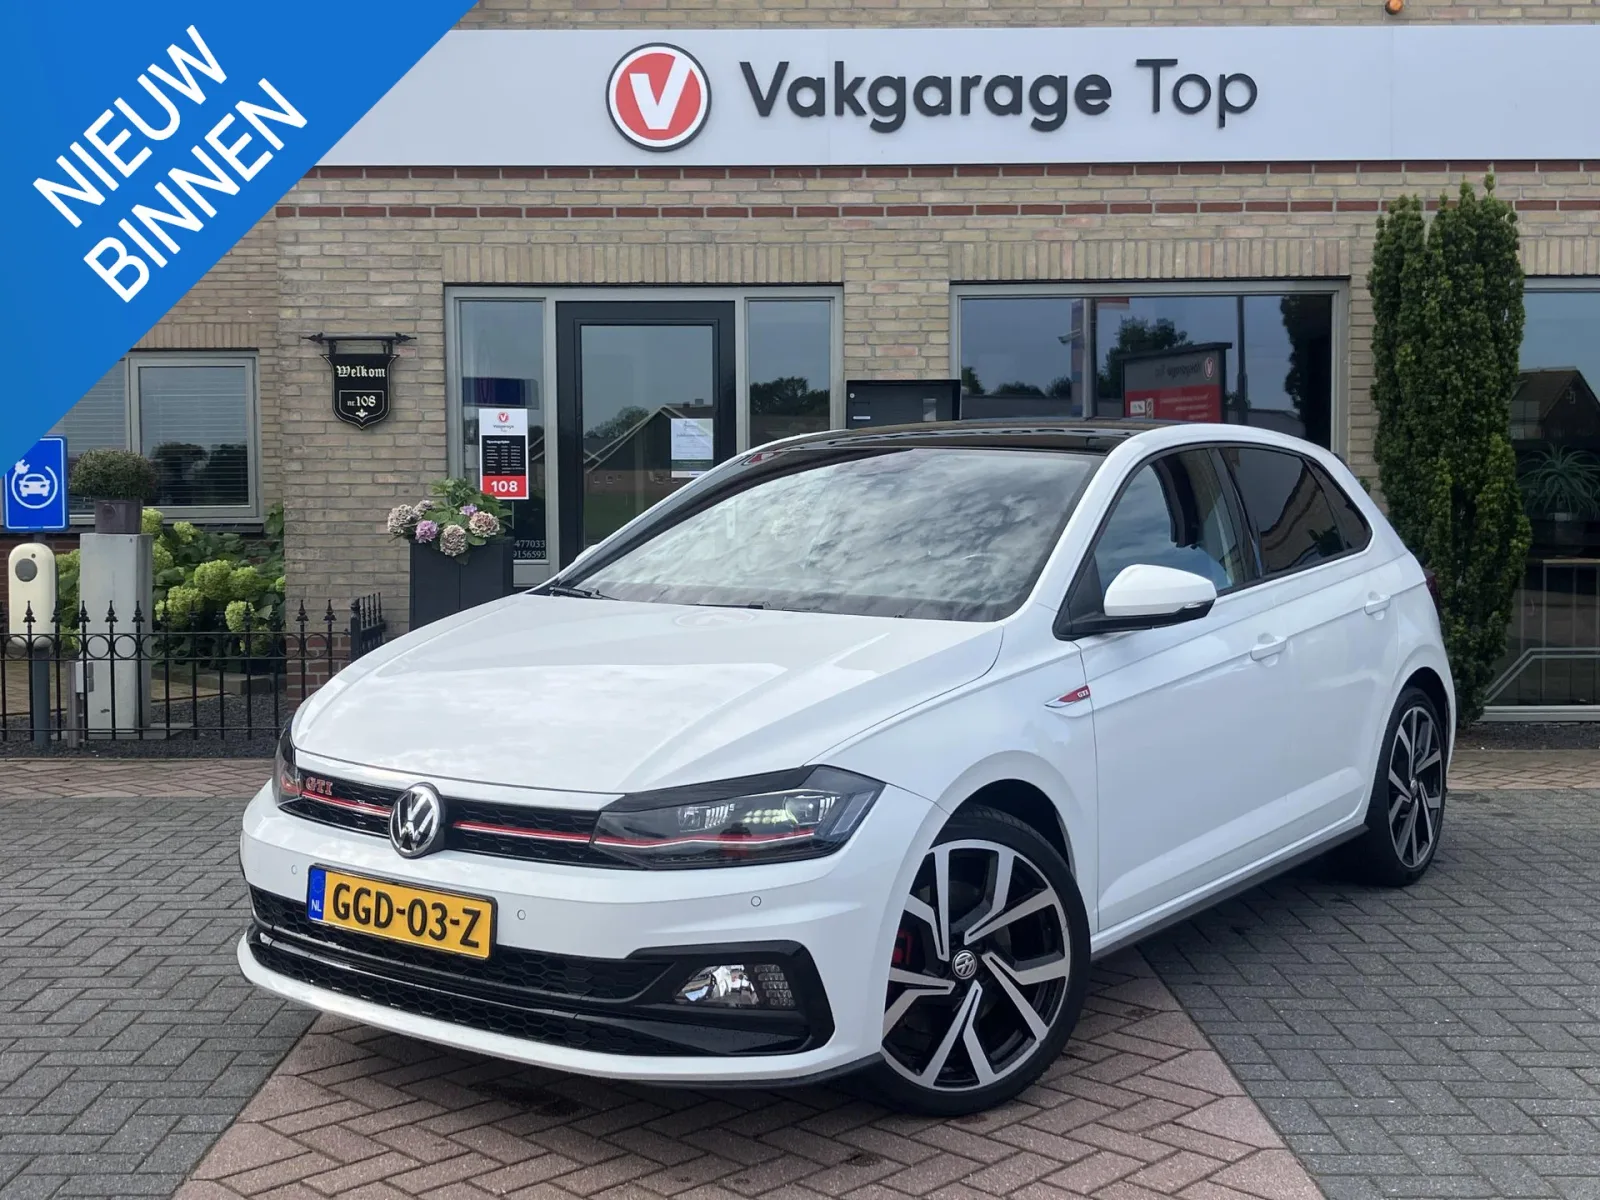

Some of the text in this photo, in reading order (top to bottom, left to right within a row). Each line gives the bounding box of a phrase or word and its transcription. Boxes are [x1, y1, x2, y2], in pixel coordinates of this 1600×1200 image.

[740, 58, 1258, 134] Vakgarage Top
[336, 365, 386, 377] Welkom
[491, 480, 518, 493] 108
[305, 776, 333, 796] GTI
[311, 899, 322, 912] NL
[332, 882, 482, 949] GGD-03-Z
